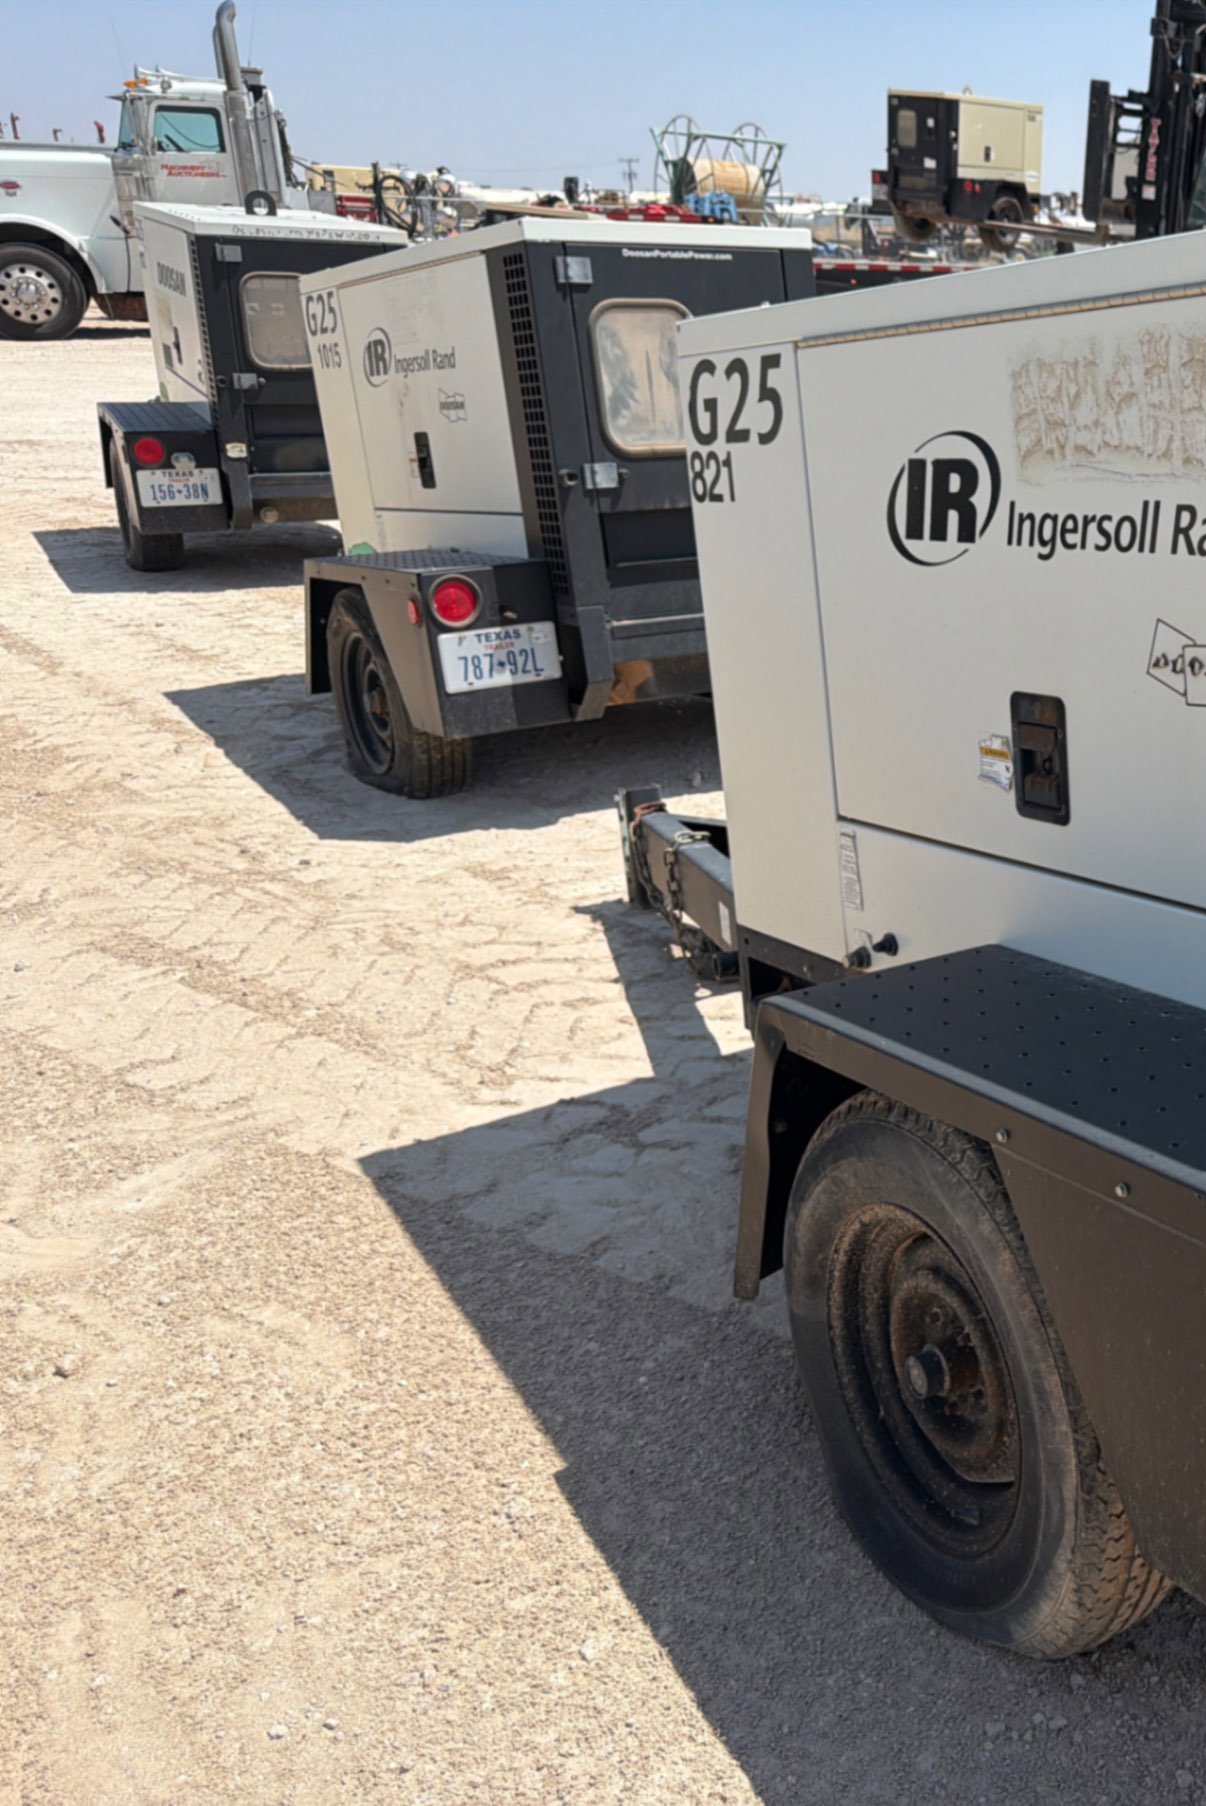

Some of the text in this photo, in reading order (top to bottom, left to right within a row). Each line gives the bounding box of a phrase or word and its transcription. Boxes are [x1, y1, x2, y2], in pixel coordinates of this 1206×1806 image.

[622, 248, 733, 261] DoosanPortablePower.com
[157, 261, 187, 298] DOOSAN
[306, 288, 337, 337] G25
[317, 342, 342, 370] 1015
[366, 338, 389, 378] IR
[394, 346, 456, 379] Ingersoll Rand
[688, 352, 784, 446] G25
[150, 482, 210, 501] 156 38N
[161, 470, 194, 478] TEXAS
[690, 450, 736, 503] 821
[905, 458, 979, 544] IR
[1007, 500, 1161, 561] Ingersoll
[475, 628, 522, 644] TEXAS
[485, 641, 515, 652] TRAILER
[458, 647, 545, 682] 787 92L
